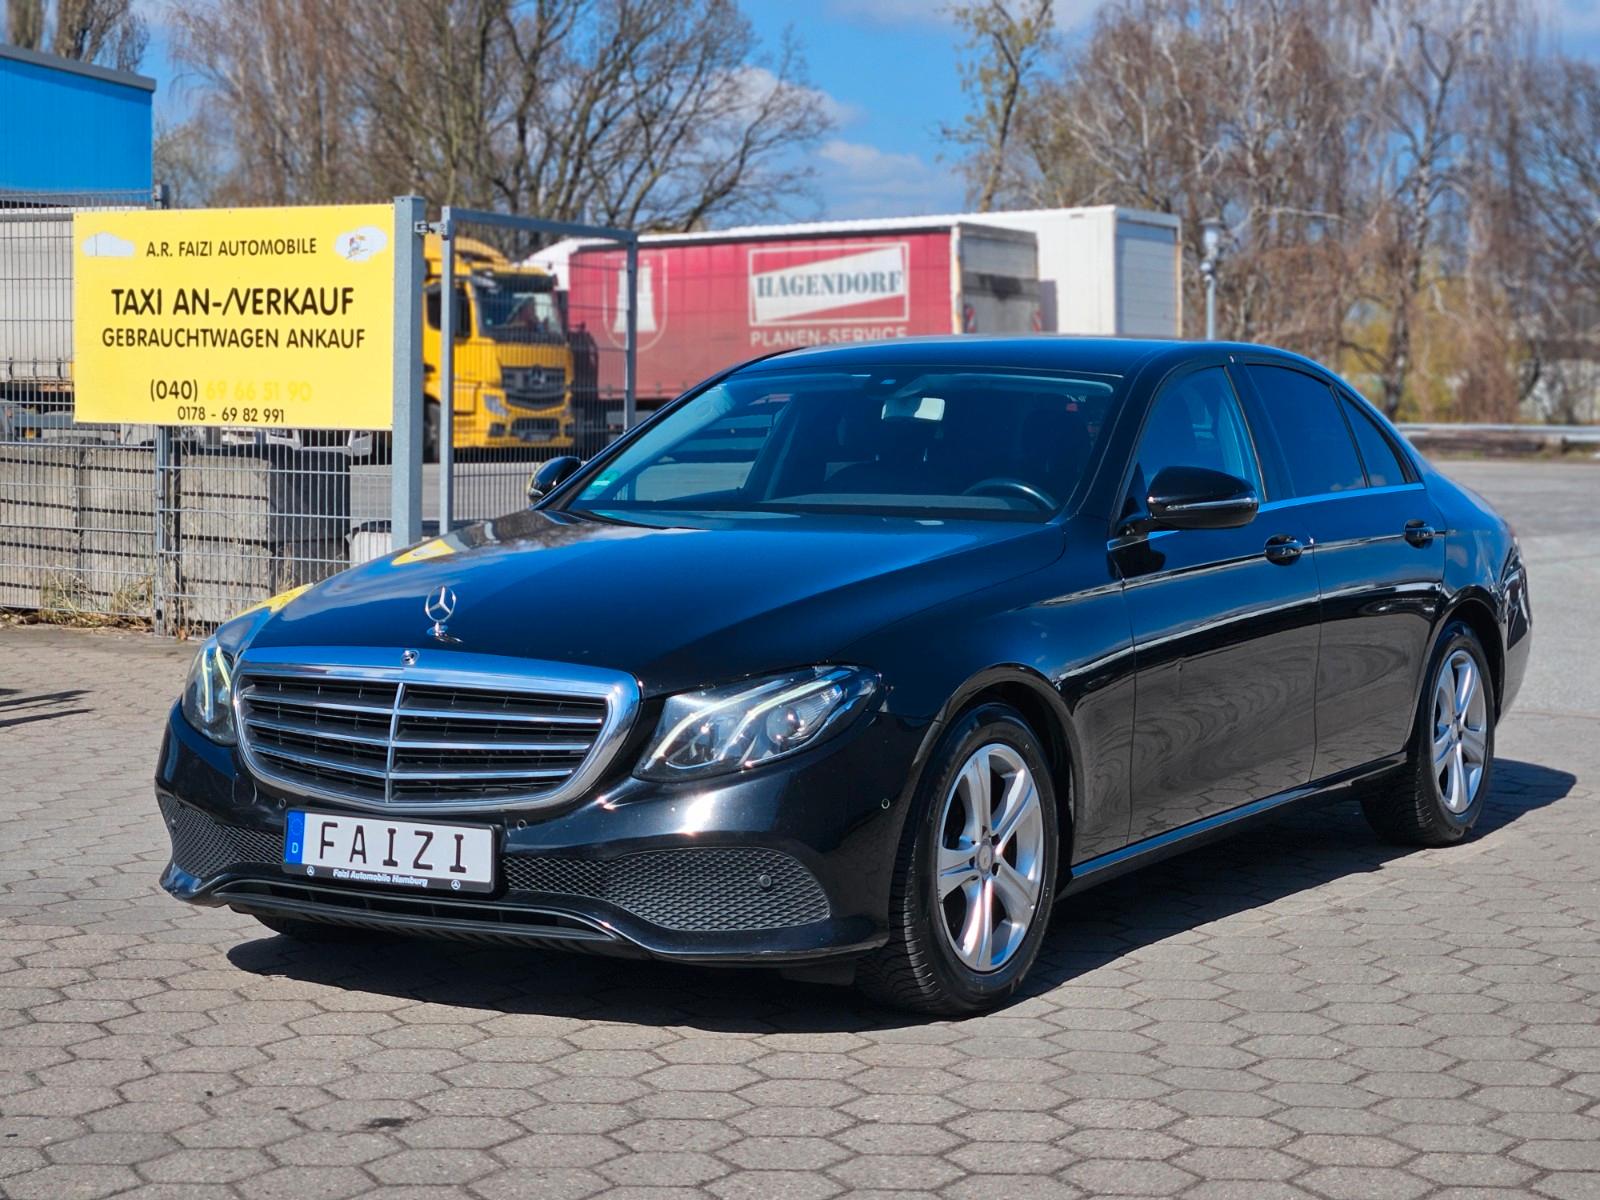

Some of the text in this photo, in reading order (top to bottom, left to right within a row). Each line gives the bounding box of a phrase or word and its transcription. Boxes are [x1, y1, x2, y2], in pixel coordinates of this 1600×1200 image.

[146, 238, 316, 257] A.R. FAIZI AUTOMOBILE
[757, 270, 904, 298] HAGENDORF
[111, 287, 354, 316] TAXI AN-/VERKAUF
[102, 327, 365, 349] GEBRAUCHTWAGEN ANKAUF
[150, 379, 198, 402] (040)
[178, 406, 205, 421] 0178
[222, 407, 238, 421] 69
[243, 408, 258, 422] 82
[264, 408, 284, 423] 991
[291, 842, 299, 853] D
[319, 821, 466, 873] FAIZI
[350, 871, 391, 883] Automobile
[392, 875, 428, 888] Hamburg
